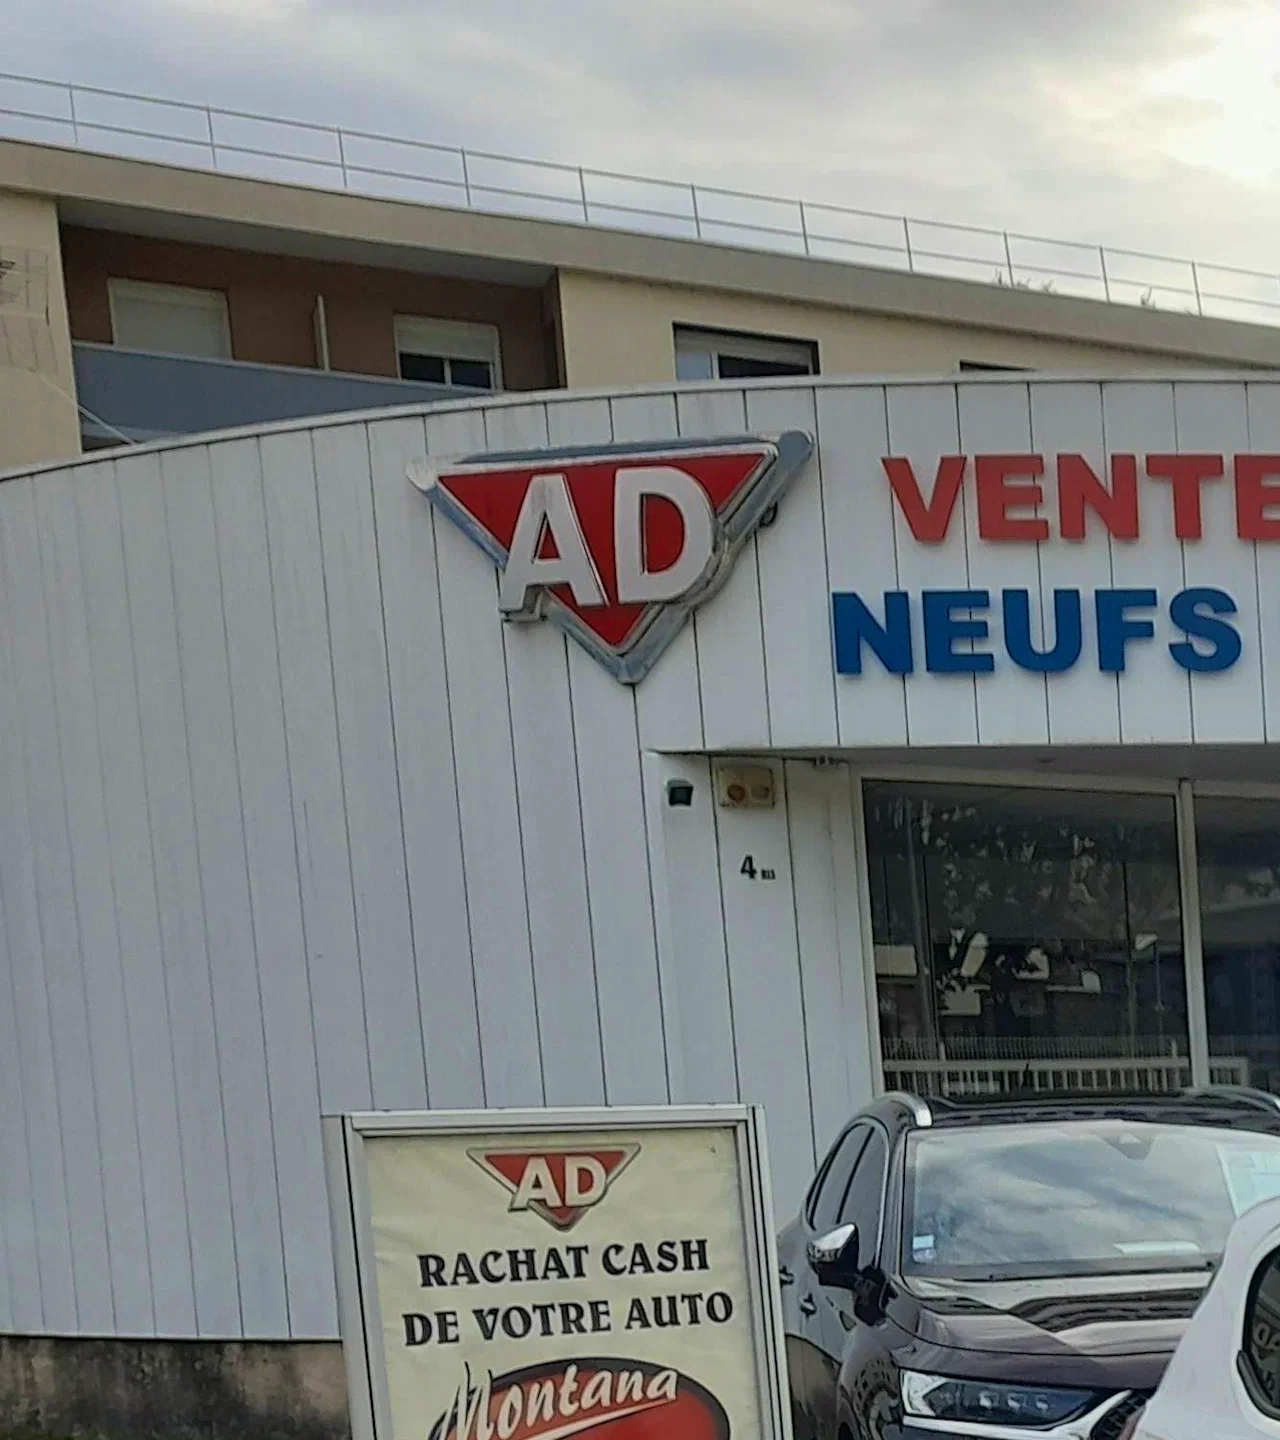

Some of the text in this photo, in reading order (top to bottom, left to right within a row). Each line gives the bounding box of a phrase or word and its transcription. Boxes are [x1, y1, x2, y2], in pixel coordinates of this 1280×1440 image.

[498, 465, 716, 613] AD
[832, 587, 1242, 674] NEUFS
[741, 855, 757, 880] 4
[509, 1155, 608, 1209] AD
[417, 1239, 710, 1287] RACHAT CASH
[402, 1291, 734, 1346] DE VOTRE AUTO
